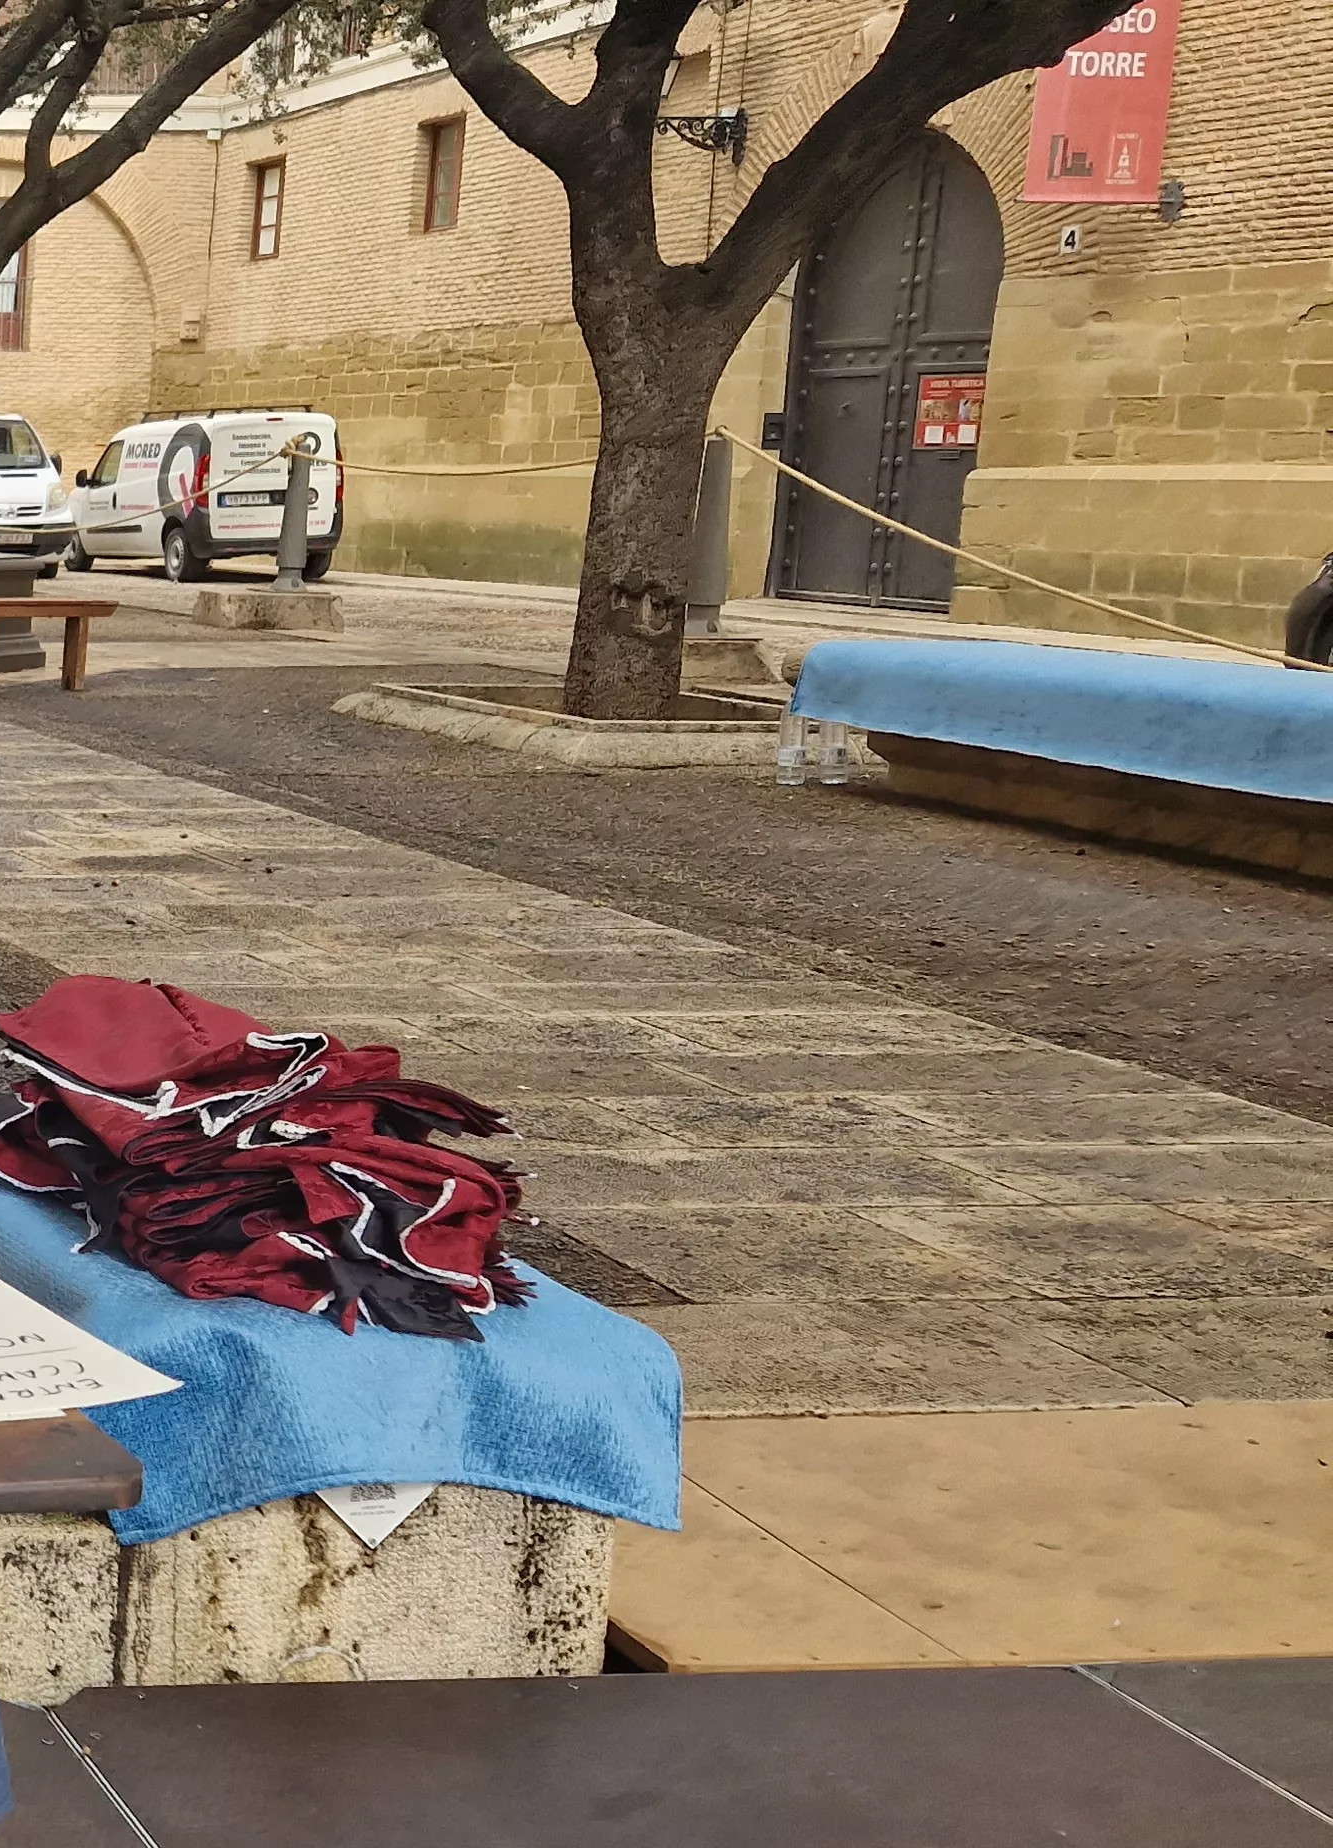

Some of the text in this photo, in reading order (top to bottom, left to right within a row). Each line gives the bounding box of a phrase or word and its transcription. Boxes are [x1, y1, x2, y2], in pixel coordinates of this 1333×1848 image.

[1106, 7, 1157, 34] SEO
[1067, 51, 1148, 77] TORRE
[1064, 229, 1077, 250] 4
[125, 443, 162, 459] MORED
